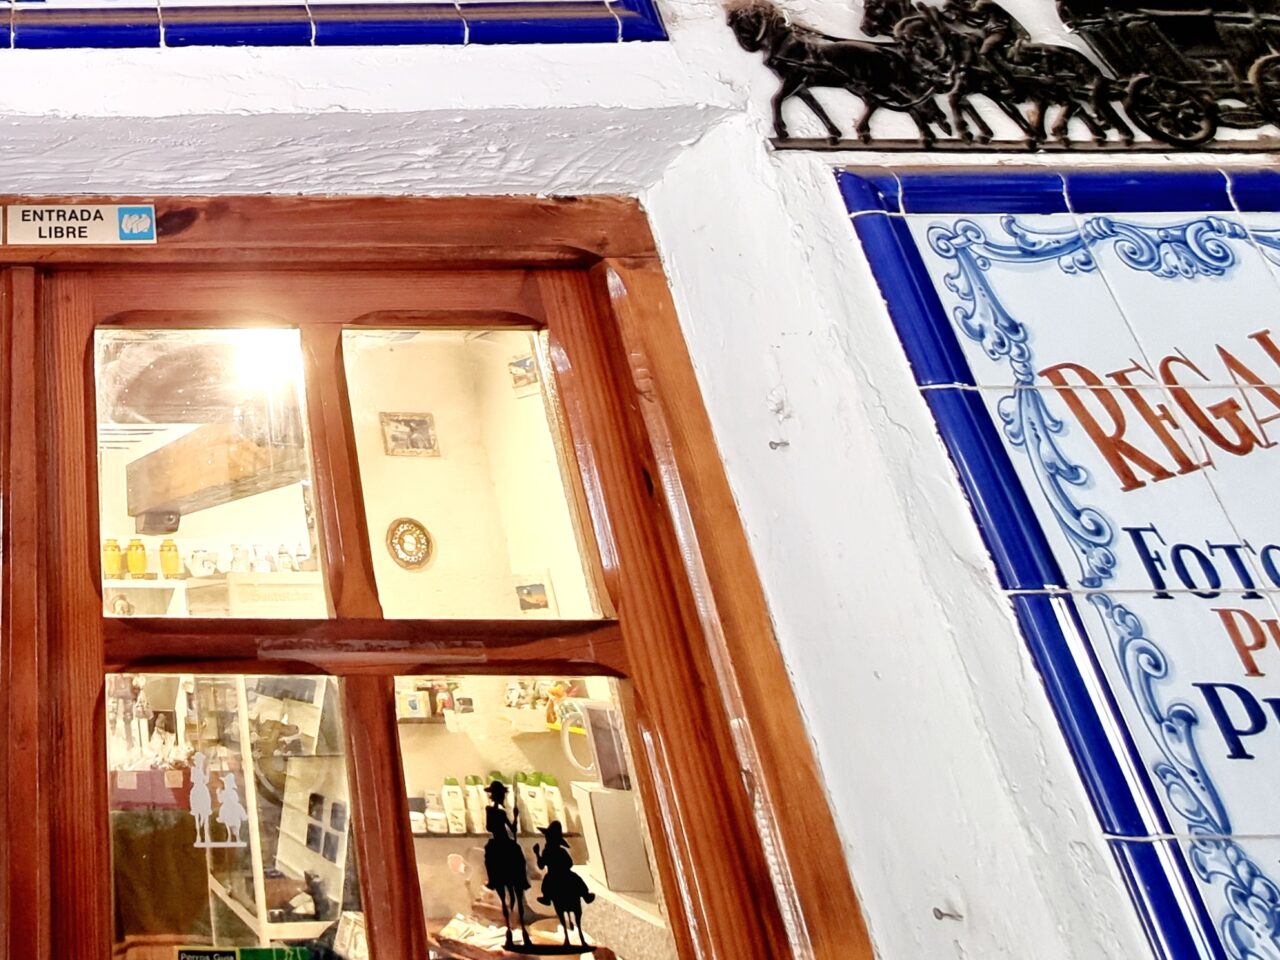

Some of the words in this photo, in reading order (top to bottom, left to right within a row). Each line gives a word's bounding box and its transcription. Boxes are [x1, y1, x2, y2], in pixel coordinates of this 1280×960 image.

[21, 209, 104, 222] ENTRADA
[38, 226, 88, 239] LIBRE
[1037, 329, 1280, 493] REGA
